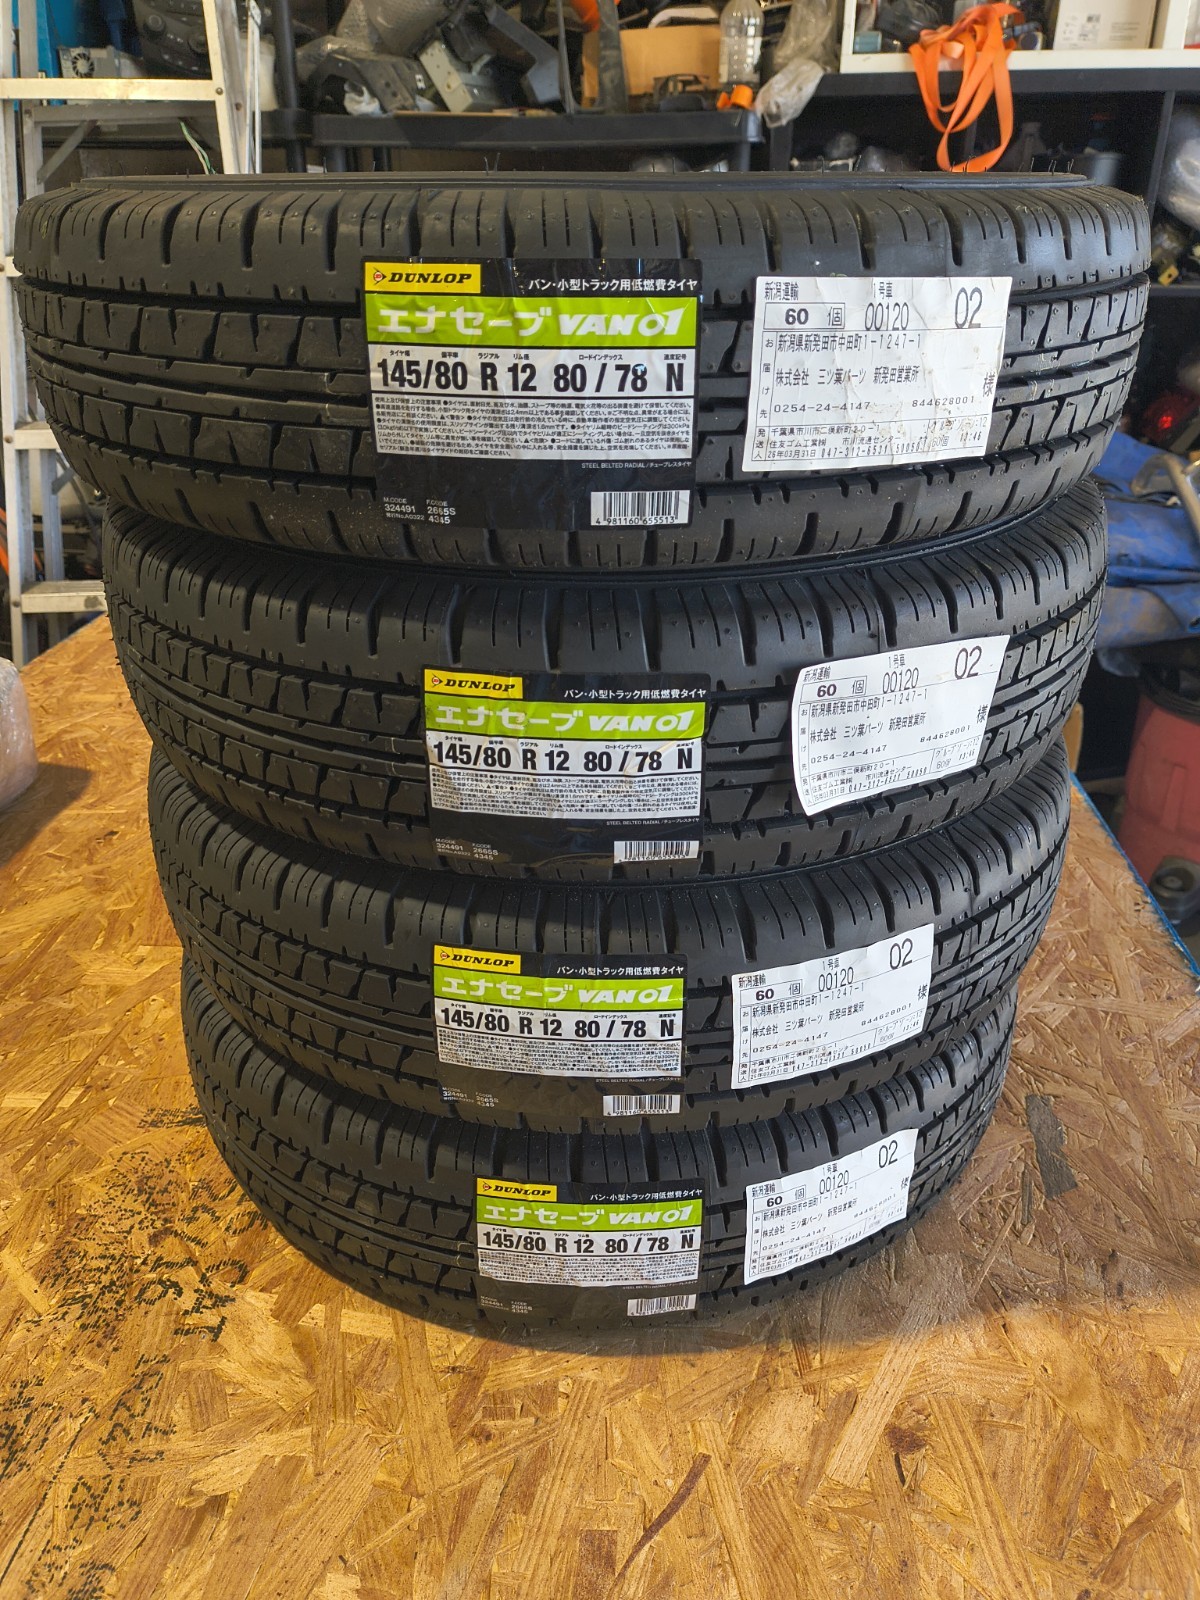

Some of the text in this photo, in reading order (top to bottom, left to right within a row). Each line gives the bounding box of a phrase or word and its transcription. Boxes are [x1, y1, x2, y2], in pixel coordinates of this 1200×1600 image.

[389, 272, 472, 284] DUNLOP
[528, 278, 698, 291] バン・小型トラック用低燃費タイヤ
[784, 306, 843, 327] 60 個
[864, 302, 909, 331] 00120
[954, 286, 983, 329] 02
[378, 305, 552, 337] エナセーブ
[377, 358, 468, 390] 145/80
[480, 362, 498, 391] R
[507, 362, 537, 392] 12
[553, 363, 587, 392] 80
[614, 363, 648, 392] 78
[666, 362, 684, 391] N
[775, 367, 809, 387] 株式会社
[873, 365, 920, 385] 新発田営業所
[774, 401, 871, 413] 0254-24-4147
[911, 395, 974, 407] 844628001
[384, 503, 416, 513] 324491
[427, 506, 456, 516] 2665S
[428, 515, 451, 524] 4345
[954, 645, 983, 680] 02
[444, 678, 516, 692] DUNLOP
[817, 679, 865, 698] 60 個
[882, 667, 919, 694] 00120
[564, 688, 707, 699] バン・小型トラック用低燃費タイヤ
[435, 705, 583, 731] エナセーブ
[810, 726, 837, 744] 株式会社
[433, 741, 512, 768] 145/80
[522, 748, 537, 770] R
[544, 750, 570, 771] 12
[583, 751, 612, 772] 80
[635, 750, 662, 772] 78
[677, 747, 693, 770] N
[811, 745, 887, 764] 0254-24-4147
[436, 842, 464, 851] 324491
[451, 953, 514, 967] DUNLOP
[889, 937, 914, 970] 02
[556, 965, 685, 976] バン・小型トラック用低燃費タイヤ
[818, 966, 854, 993] 00120
[441, 977, 574, 1003] エナセーブ
[738, 974, 766, 988] 新潟運輸
[755, 988, 775, 1001] 60
[440, 1007, 510, 1032] 145/80
[519, 1016, 533, 1035] R
[539, 1018, 562, 1037] 12
[574, 1020, 600, 1038] 80
[621, 1020, 646, 1038] 78
[660, 1019, 674, 1037] N
[752, 1024, 778, 1039] 株式会社
[752, 1031, 828, 1053] 0254-24-4147
[877, 1139, 899, 1169] 02
[493, 1184, 552, 1196] DUNLOP
[819, 1169, 849, 1195] 00120
[590, 1188, 703, 1202] バン・小型トラック用低燃費タイヤ
[766, 1195, 783, 1208] 60
[483, 1205, 605, 1226] エナセーブ
[483, 1231, 547, 1252] 145/80
[555, 1237, 568, 1253] R
[573, 1238, 594, 1254] 12
[605, 1238, 629, 1254] 80
[646, 1236, 670, 1252] 78
[681, 1233, 694, 1250] N
